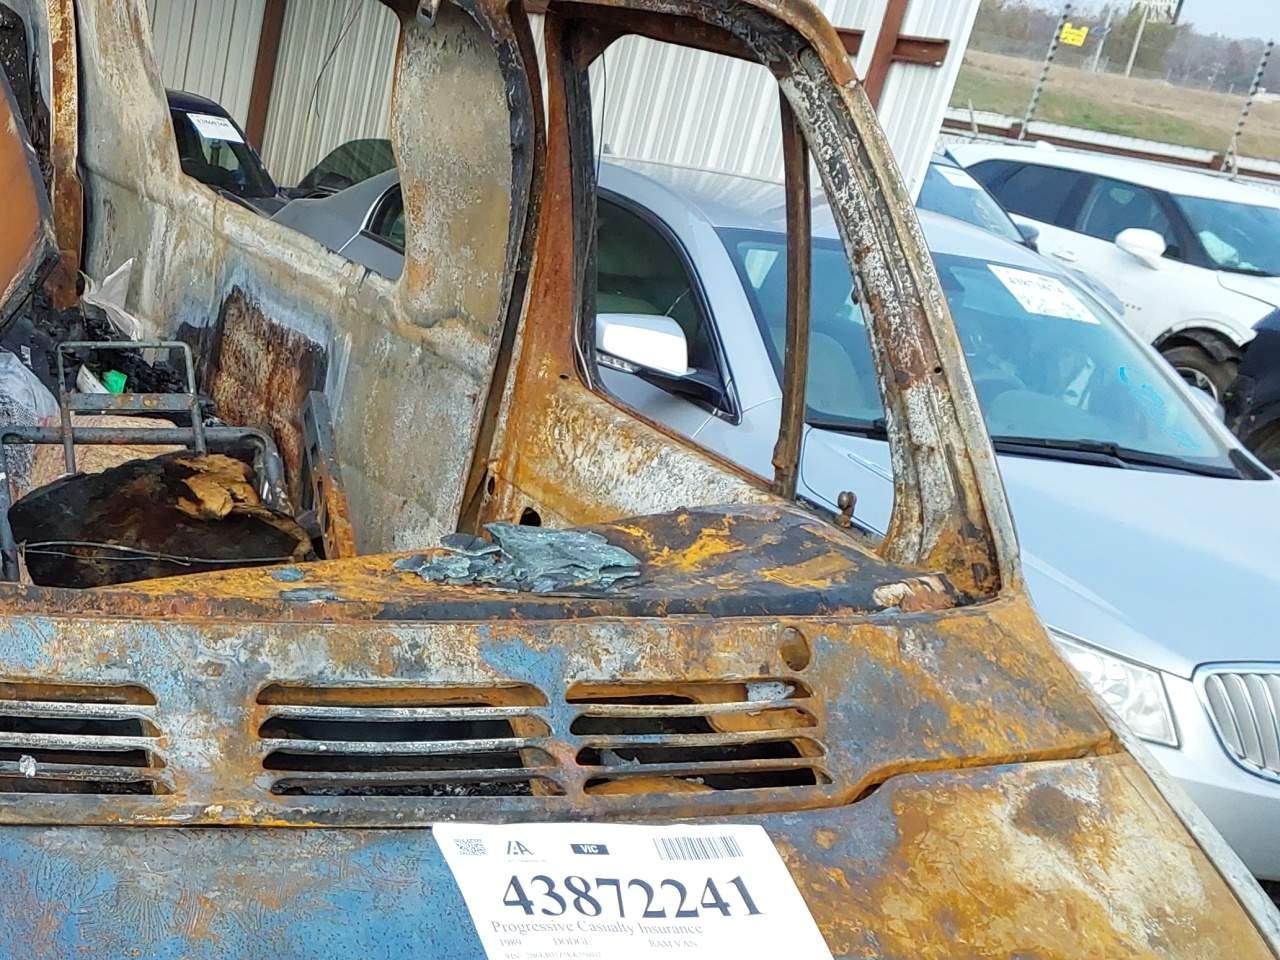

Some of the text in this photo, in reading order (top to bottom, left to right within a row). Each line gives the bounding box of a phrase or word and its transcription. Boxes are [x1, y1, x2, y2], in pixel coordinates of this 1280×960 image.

[579, 844, 599, 853] VIC
[502, 874, 766, 918] 43872241
[491, 920, 704, 936] Progressive Casualty Insurance
